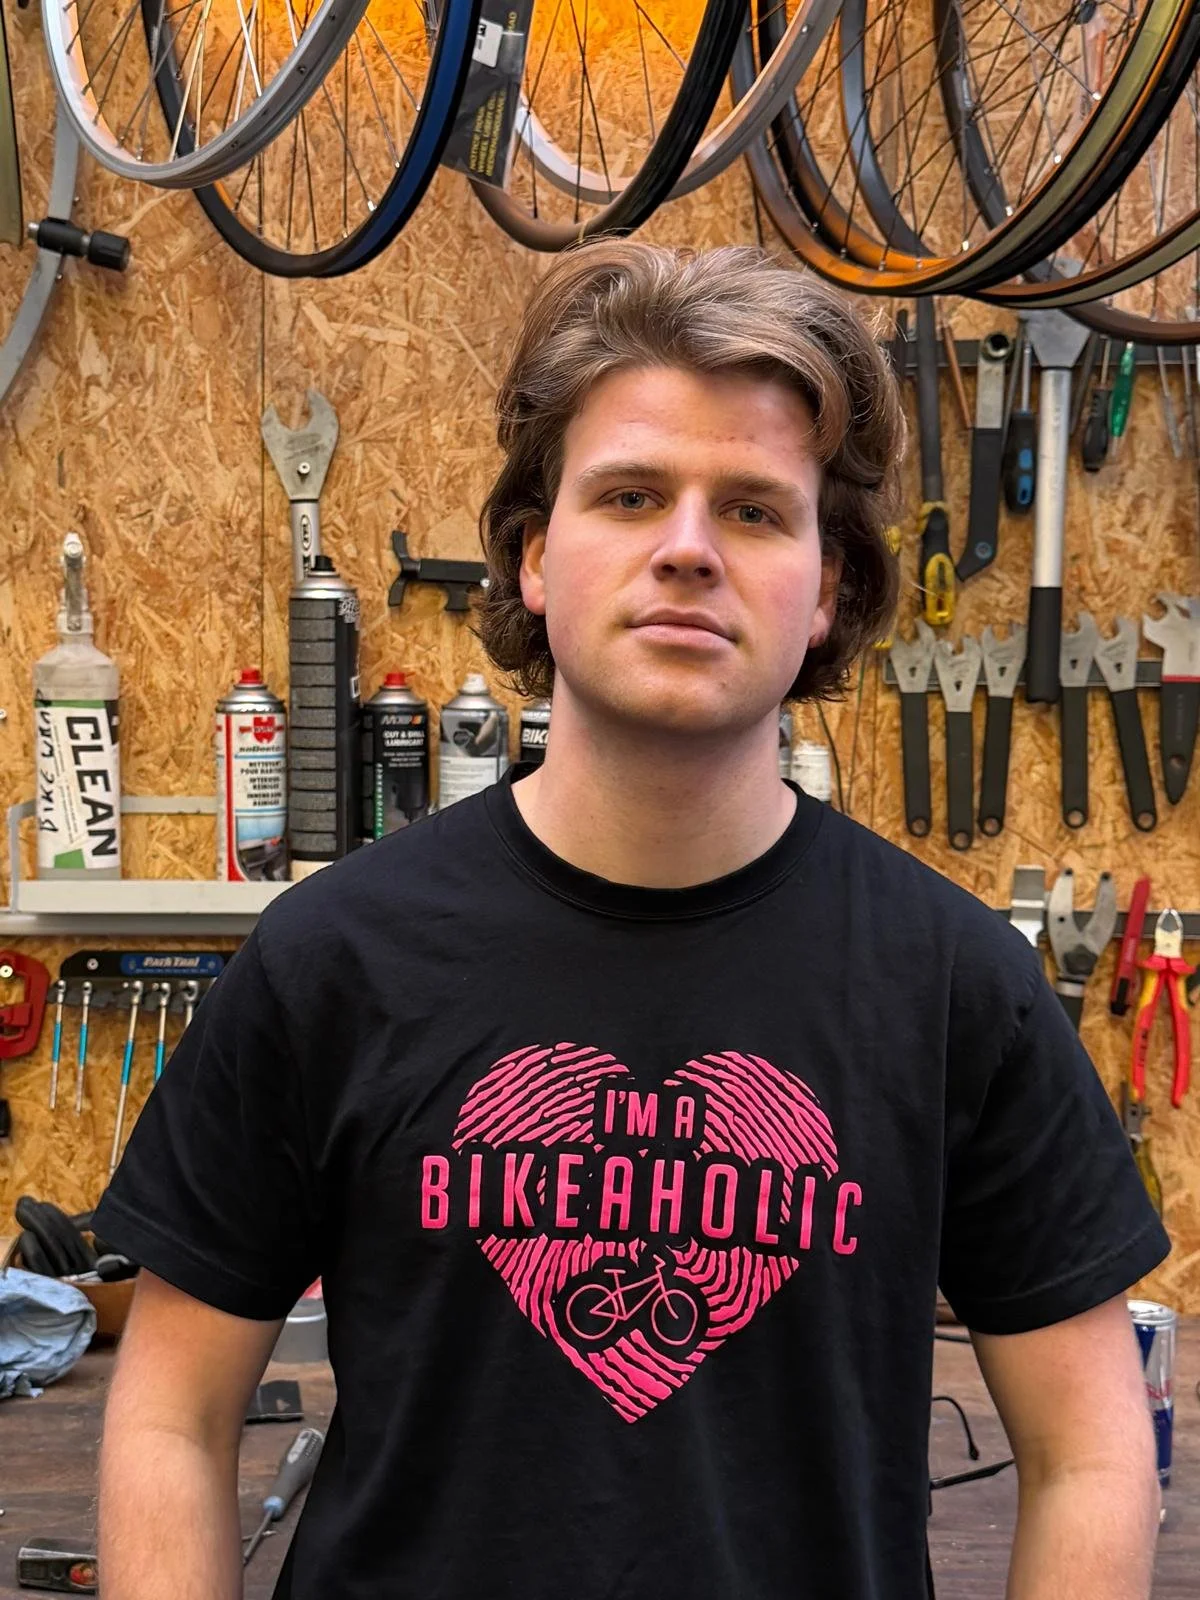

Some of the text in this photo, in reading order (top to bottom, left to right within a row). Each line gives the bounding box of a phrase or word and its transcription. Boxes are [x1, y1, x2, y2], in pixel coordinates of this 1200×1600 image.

[66, 716, 118, 856] CLEAN
[604, 1089, 695, 1139] I'M A
[420, 1153, 863, 1256] BIKEAHOLIC
